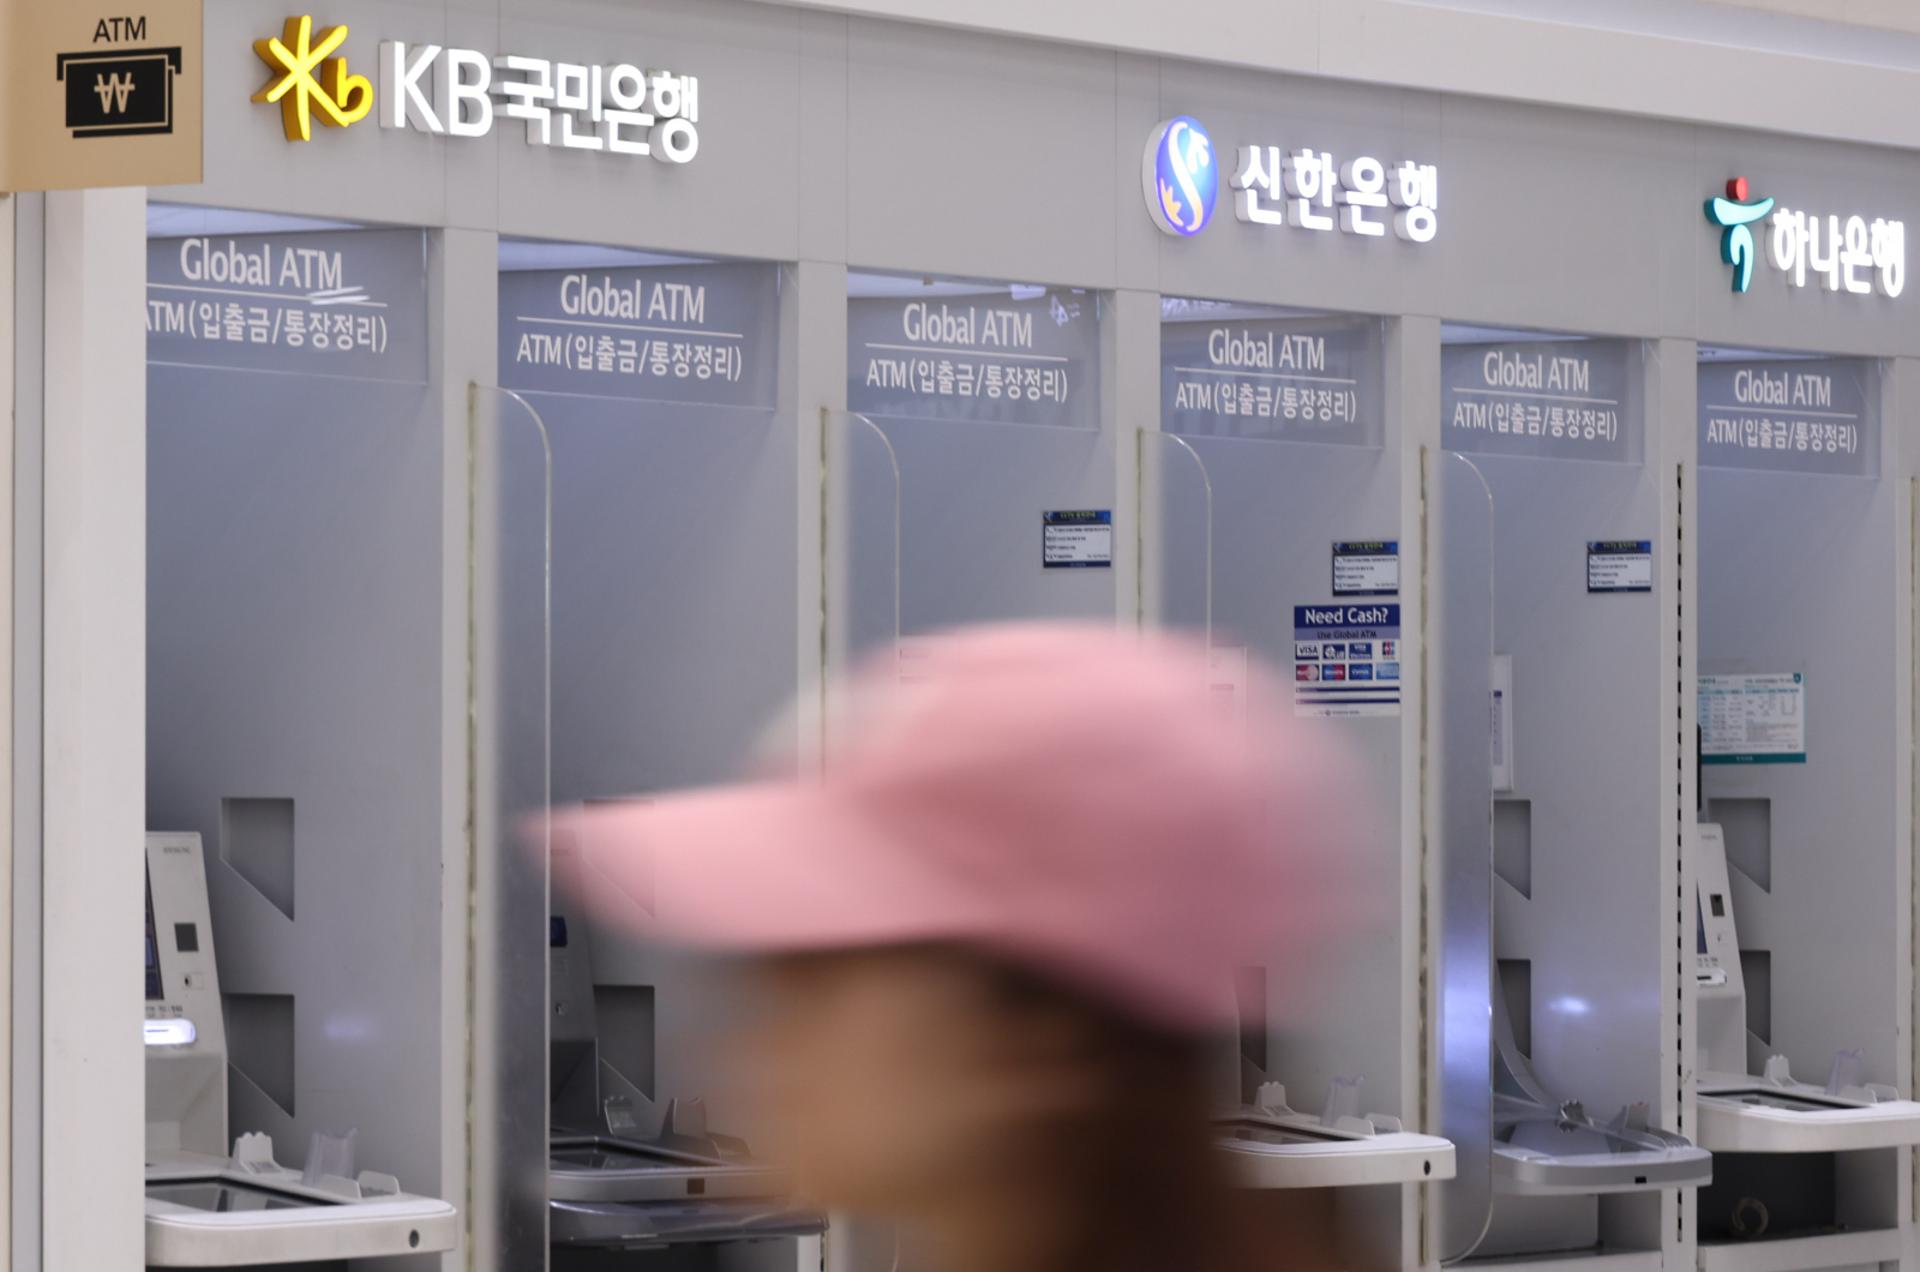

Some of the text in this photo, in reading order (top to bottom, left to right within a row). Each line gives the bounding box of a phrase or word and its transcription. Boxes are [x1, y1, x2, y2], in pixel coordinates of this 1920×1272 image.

[93, 16, 147, 43] ATM
[381, 41, 699, 163] KB국민은행
[1229, 145, 1437, 242] 신한은행
[180, 238, 342, 290] Global ATM
[1768, 208, 1905, 298] 하나은행
[561, 274, 705, 324] Global ATM
[903, 302, 1032, 348] Global ATM
[1208, 328, 1325, 371] Global ATM
[1484, 351, 1589, 392] Global ATM
[1734, 369, 1831, 408] Global ATM
[1305, 607, 1388, 625] Need Cash?
[1317, 629, 1377, 640] Use Global ATM
[1299, 645, 1318, 654] VISA
